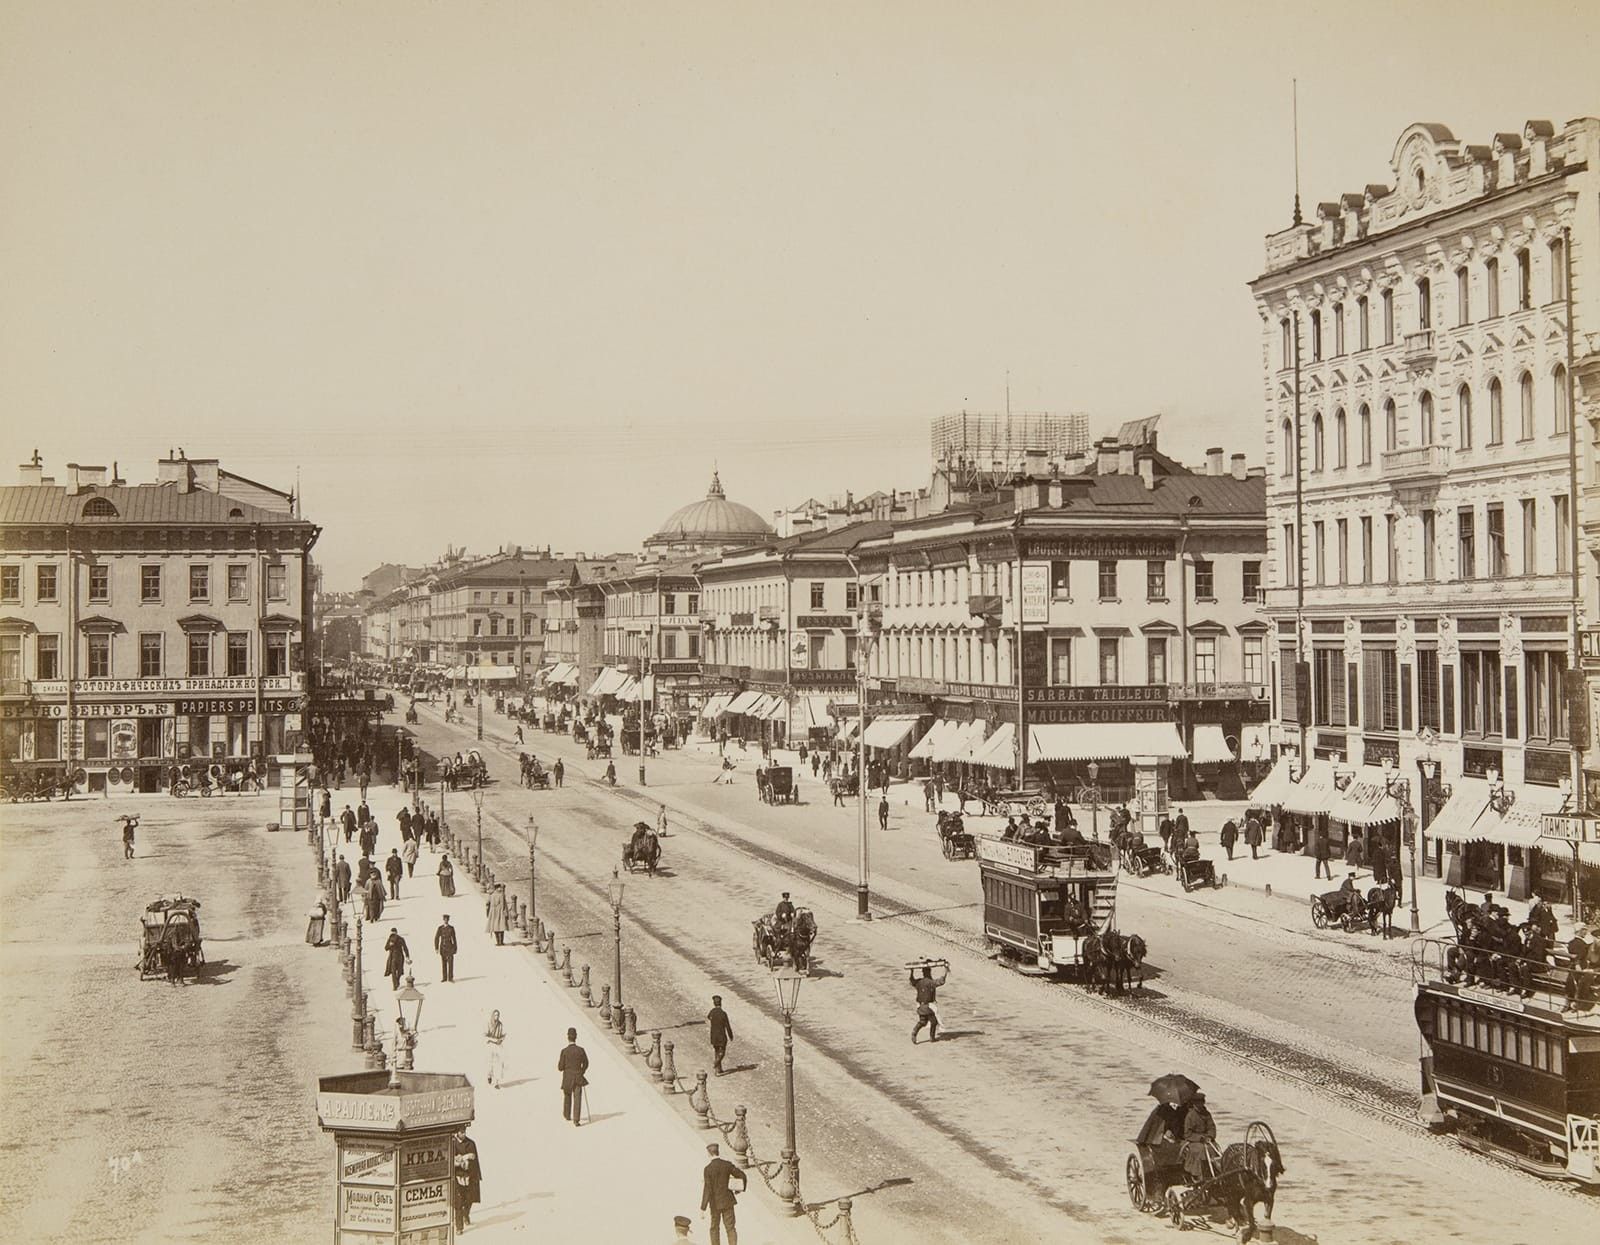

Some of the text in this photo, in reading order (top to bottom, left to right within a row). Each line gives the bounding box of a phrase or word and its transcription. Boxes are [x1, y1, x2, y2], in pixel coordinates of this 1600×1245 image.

[1027, 689, 1084, 701] SARRAT
[1093, 688, 1162, 700] TAILLEUR
[181, 700, 285, 713] PAPIERS PENTS.
[1027, 709, 1086, 722] MAULLE
[405, 1184, 443, 1203] СЕМЬЯ
